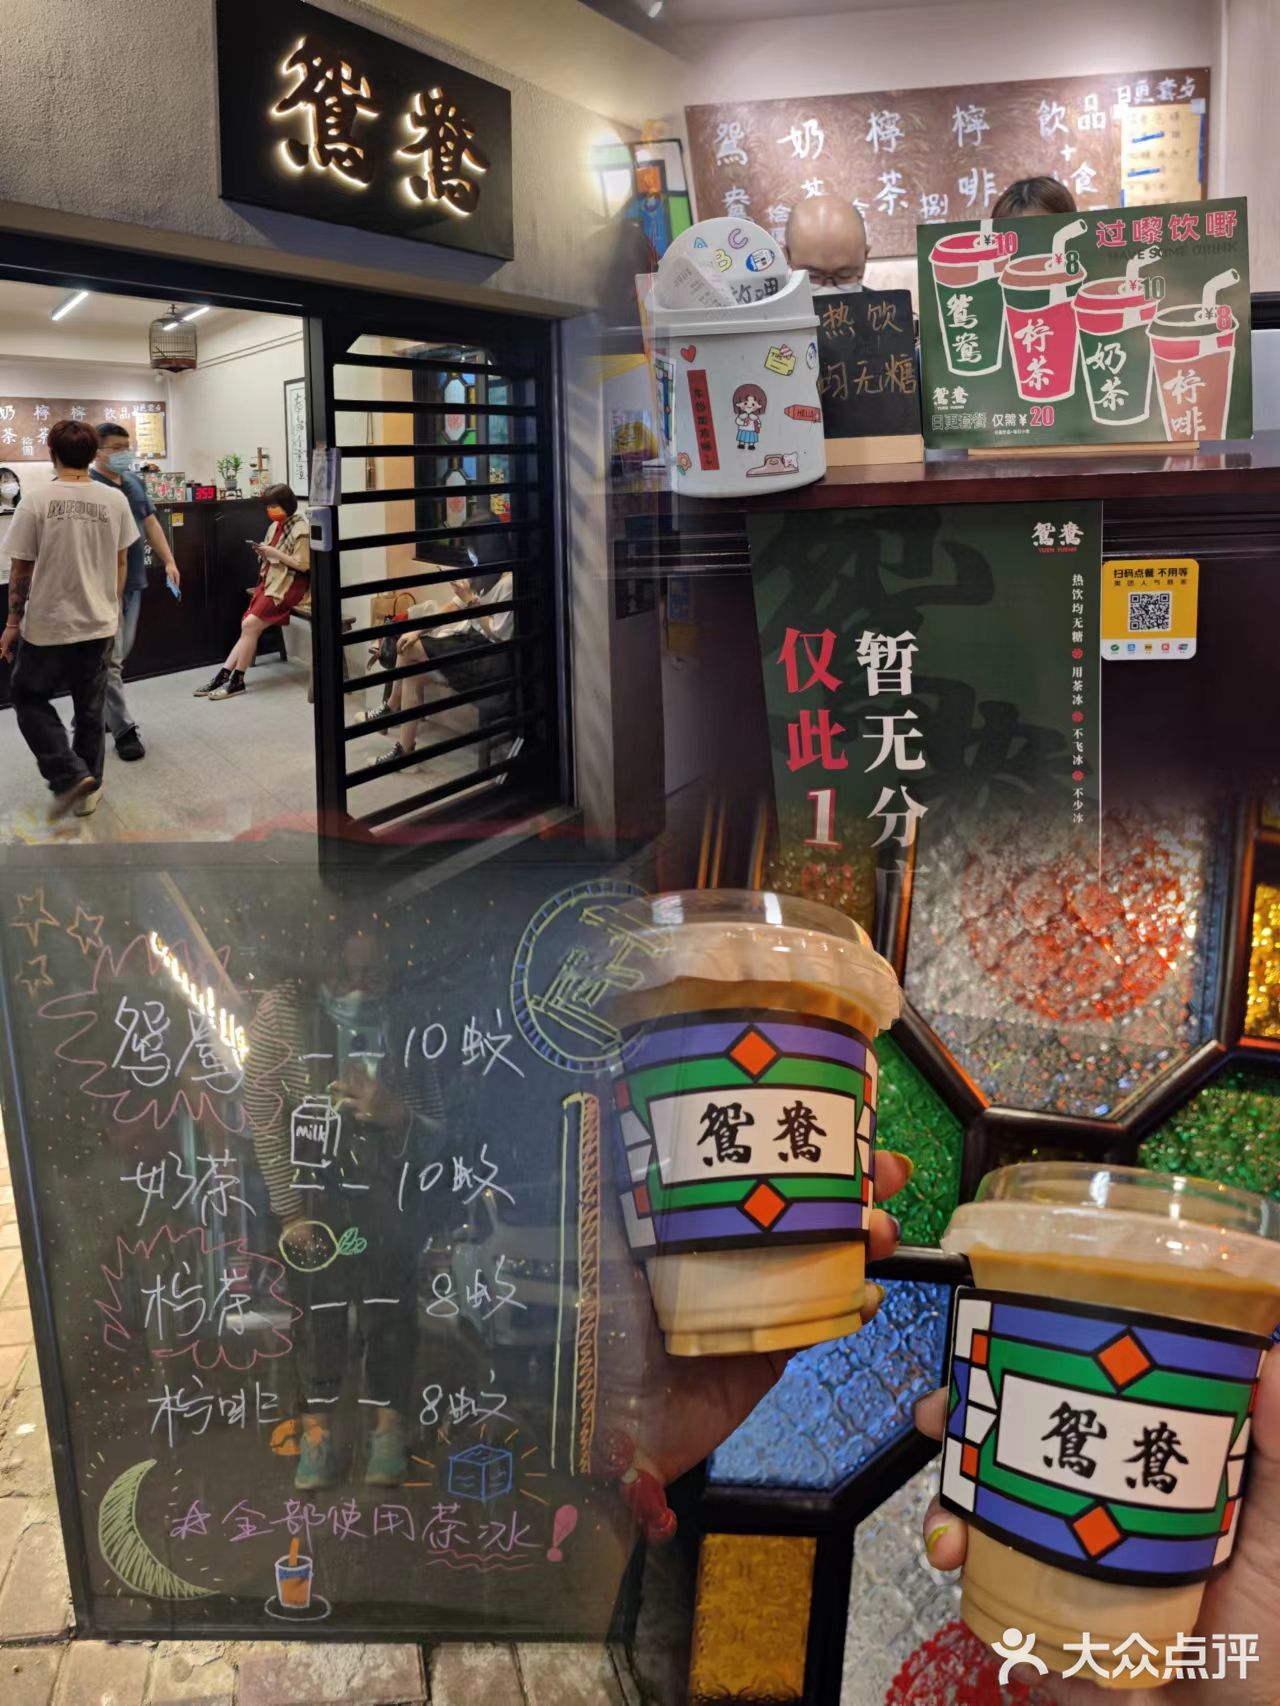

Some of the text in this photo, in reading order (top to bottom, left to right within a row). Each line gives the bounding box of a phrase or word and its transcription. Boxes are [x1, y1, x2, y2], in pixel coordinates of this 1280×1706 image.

[823, 300, 904, 340] 热饮
[1013, 319, 1055, 391] 柠茶
[1086, 342, 1129, 412] 奶茶
[1163, 369, 1207, 441] 柠啡
[1113, 567, 1189, 579] 扫码点餐 不用等
[1071, 573, 1084, 823] 热饮均无糖 用茶冰 不飞冰 不少冰
[776, 627, 849, 852] 仅此1
[697, 1100, 827, 1167] 鴛鴦
[120, 1149, 257, 1227] 奶茶
[1041, 1401, 1189, 1494] 鴛鴦
